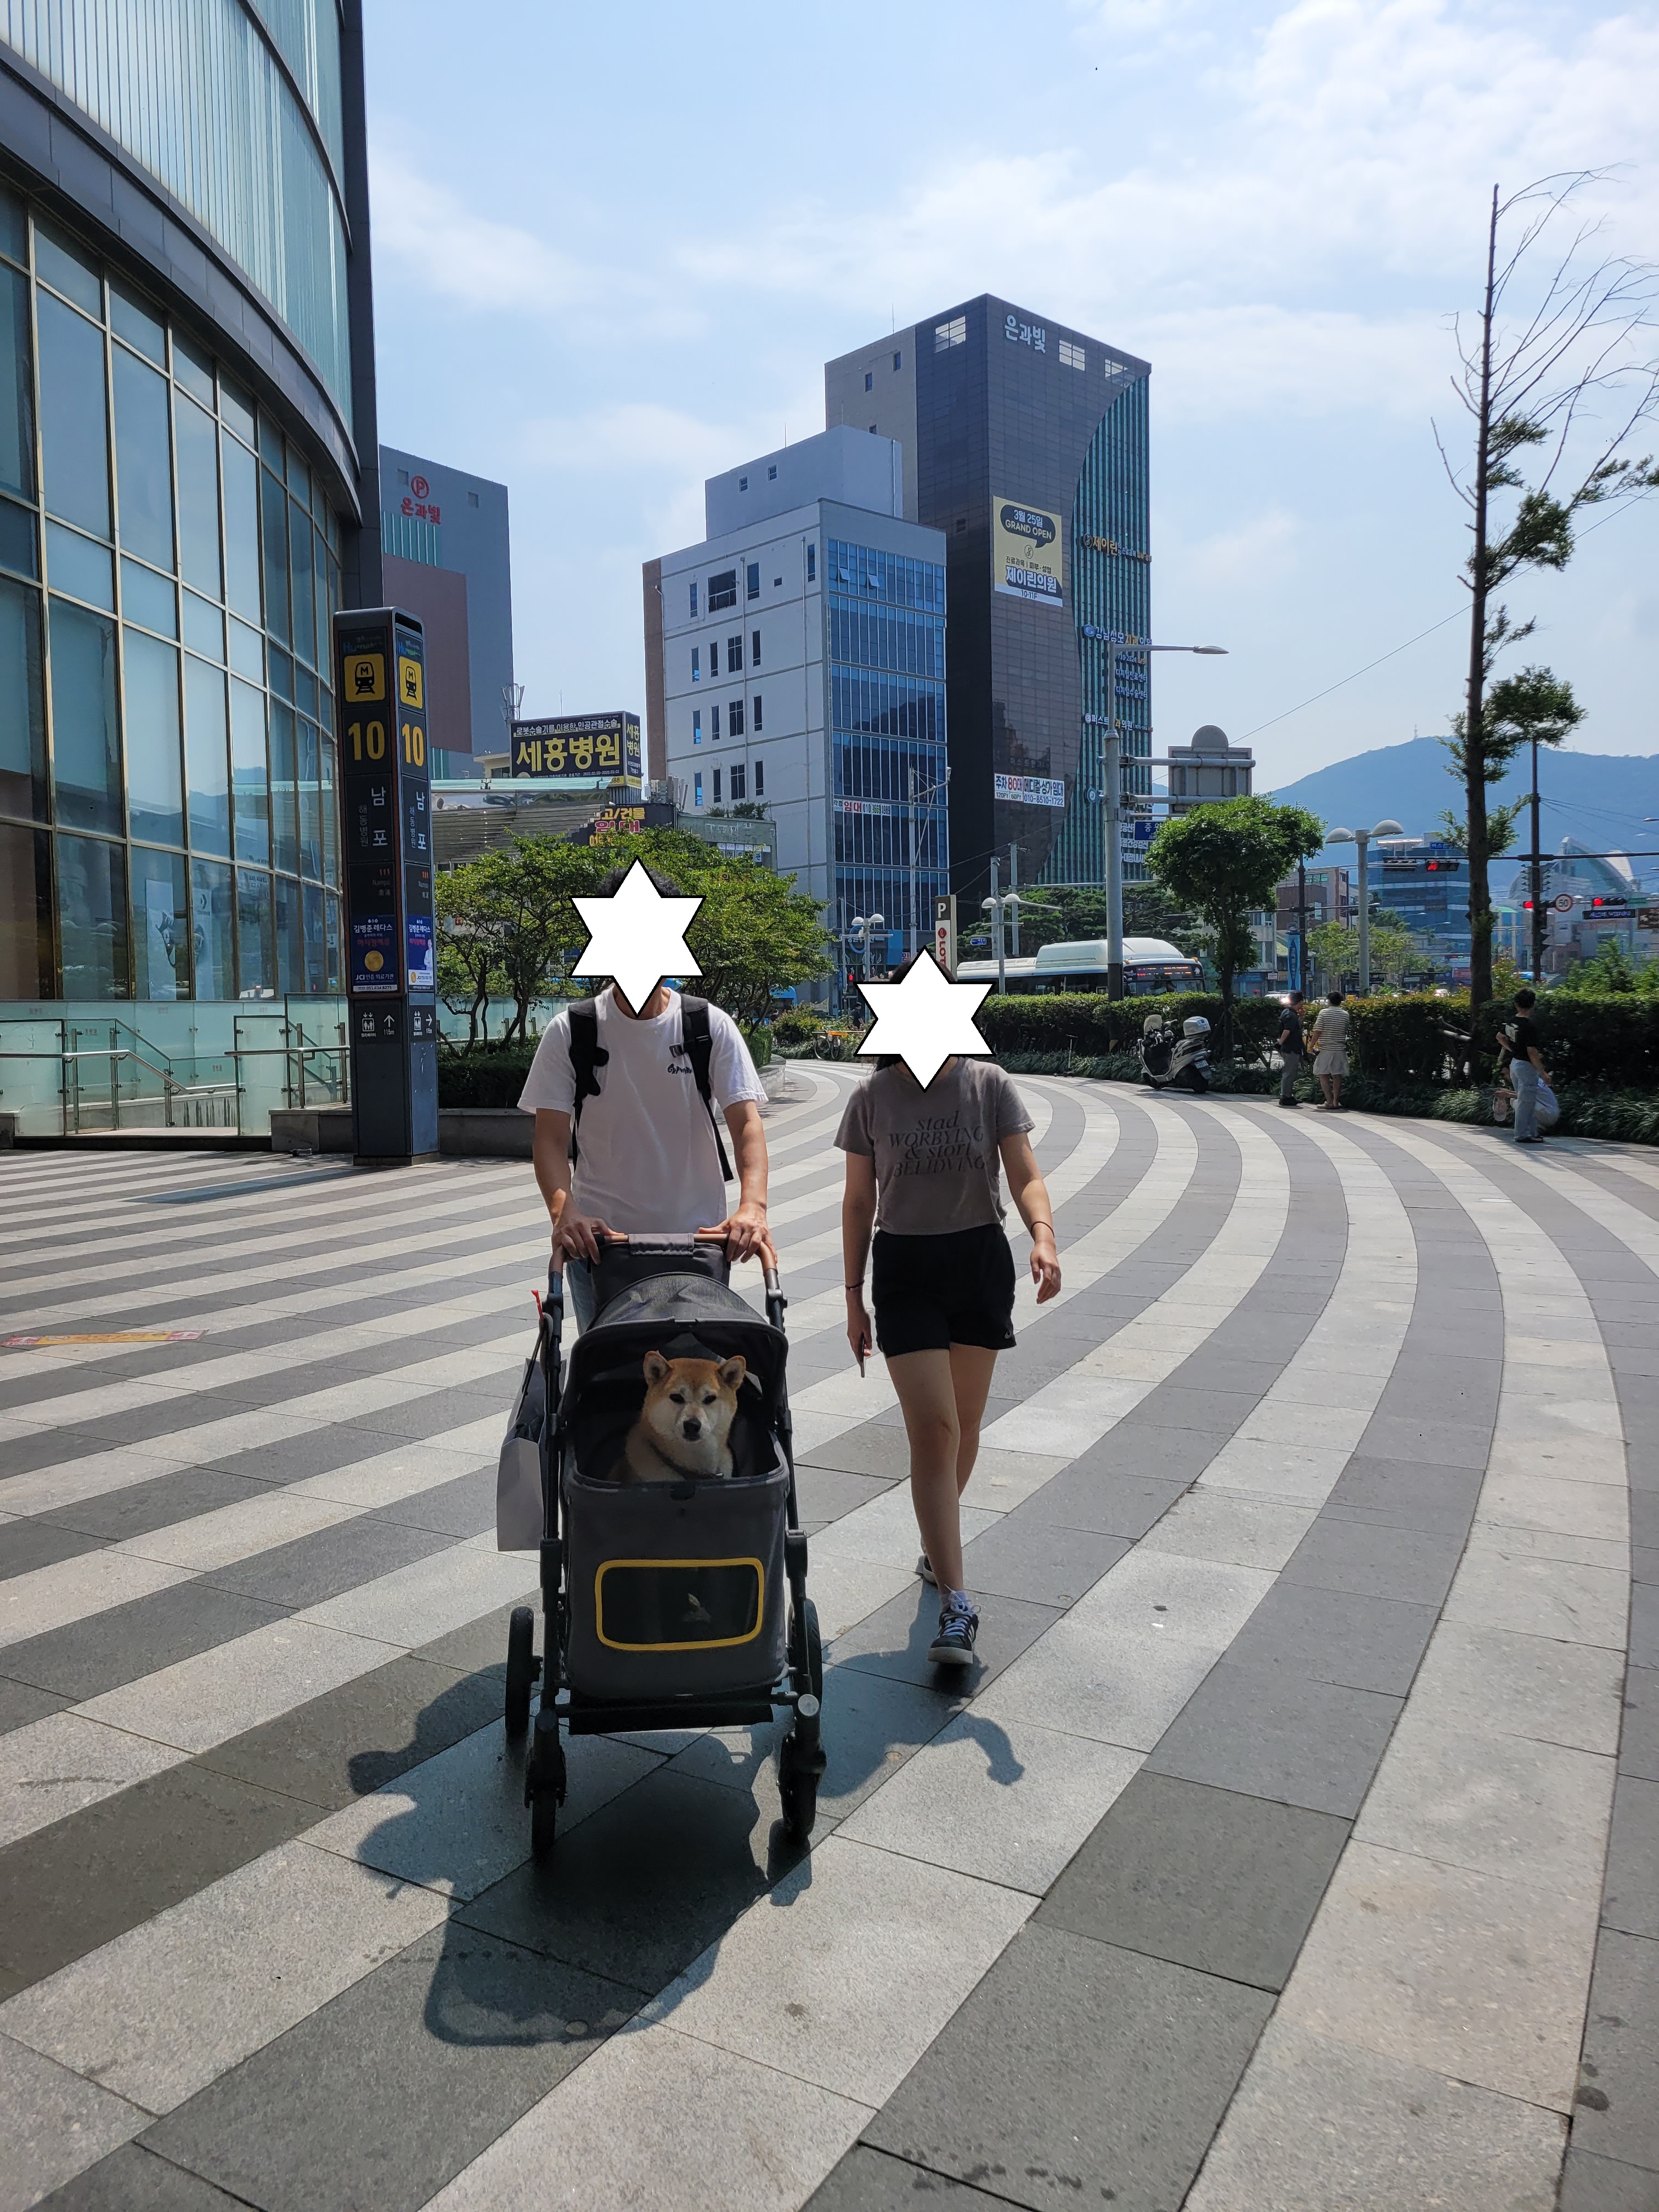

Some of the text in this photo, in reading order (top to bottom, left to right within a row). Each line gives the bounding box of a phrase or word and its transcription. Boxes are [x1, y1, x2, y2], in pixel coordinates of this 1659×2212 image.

[1014, 510, 1042, 528] 3월 25일
[1005, 520, 1052, 540] GRAND OPEN
[1093, 535, 1118, 556] 제이린
[1006, 566, 1057, 594] 제이린의원
[556, 723, 577, 732] 이용한
[578, 719, 618, 730] 인공관절수술
[348, 721, 385, 761] 10
[402, 723, 424, 767] 10
[627, 740, 640, 757] 병원
[996, 775, 1007, 790] 주차
[1008, 777, 1022, 792] 80대
[844, 801, 862, 812] 임대
[863, 803, 871, 813] 010
[1024, 794, 1064, 805] 010-8510-1722
[594, 807, 645, 820] 고/건물
[938, 902, 946, 918] P
[1558, 899, 1568, 907] 50
